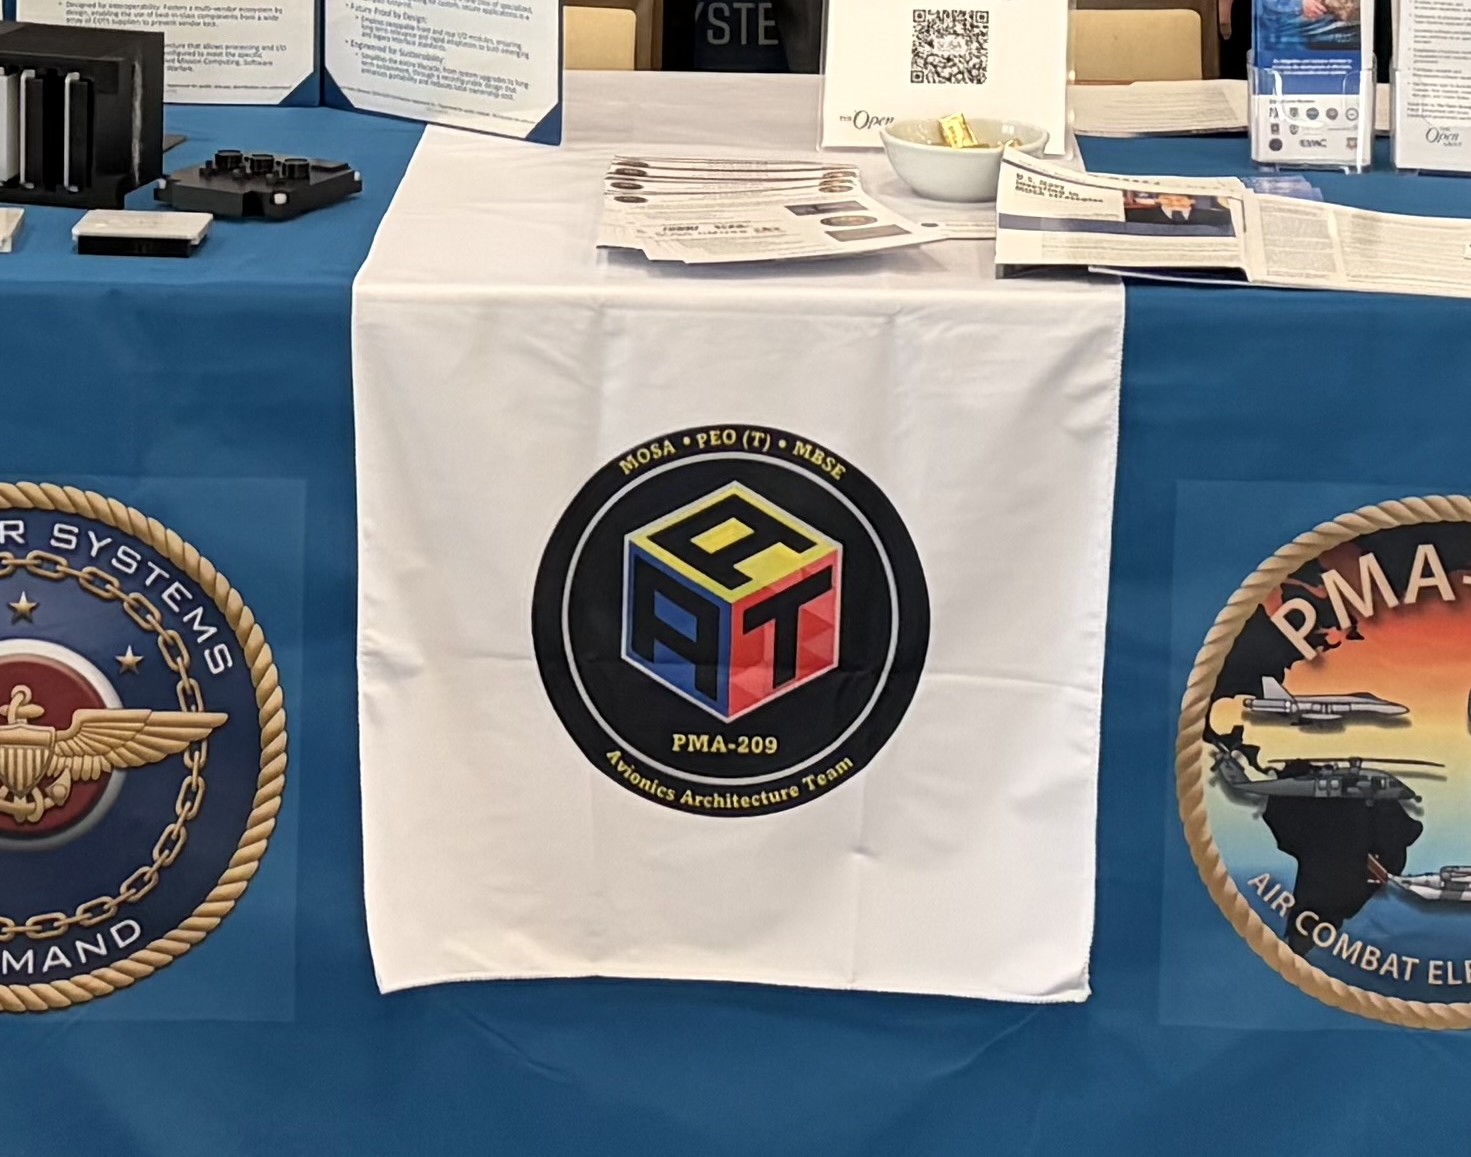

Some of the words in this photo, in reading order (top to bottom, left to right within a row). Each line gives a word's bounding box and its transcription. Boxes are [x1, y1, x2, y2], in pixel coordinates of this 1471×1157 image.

[618, 439, 676, 475] MOSA
[696, 428, 737, 449] PEO
[742, 430, 772, 452] (T)
[792, 440, 847, 481] MBSE
[50, 523, 234, 675] SYSTEMS
[671, 733, 779, 754] PMA-209
[606, 748, 676, 802] Avionics
[680, 783, 800, 809] Architecture
[802, 756, 854, 791] Team
[1247, 871, 1292, 919] AIR
[1295, 908, 1421, 983] COMBAT
